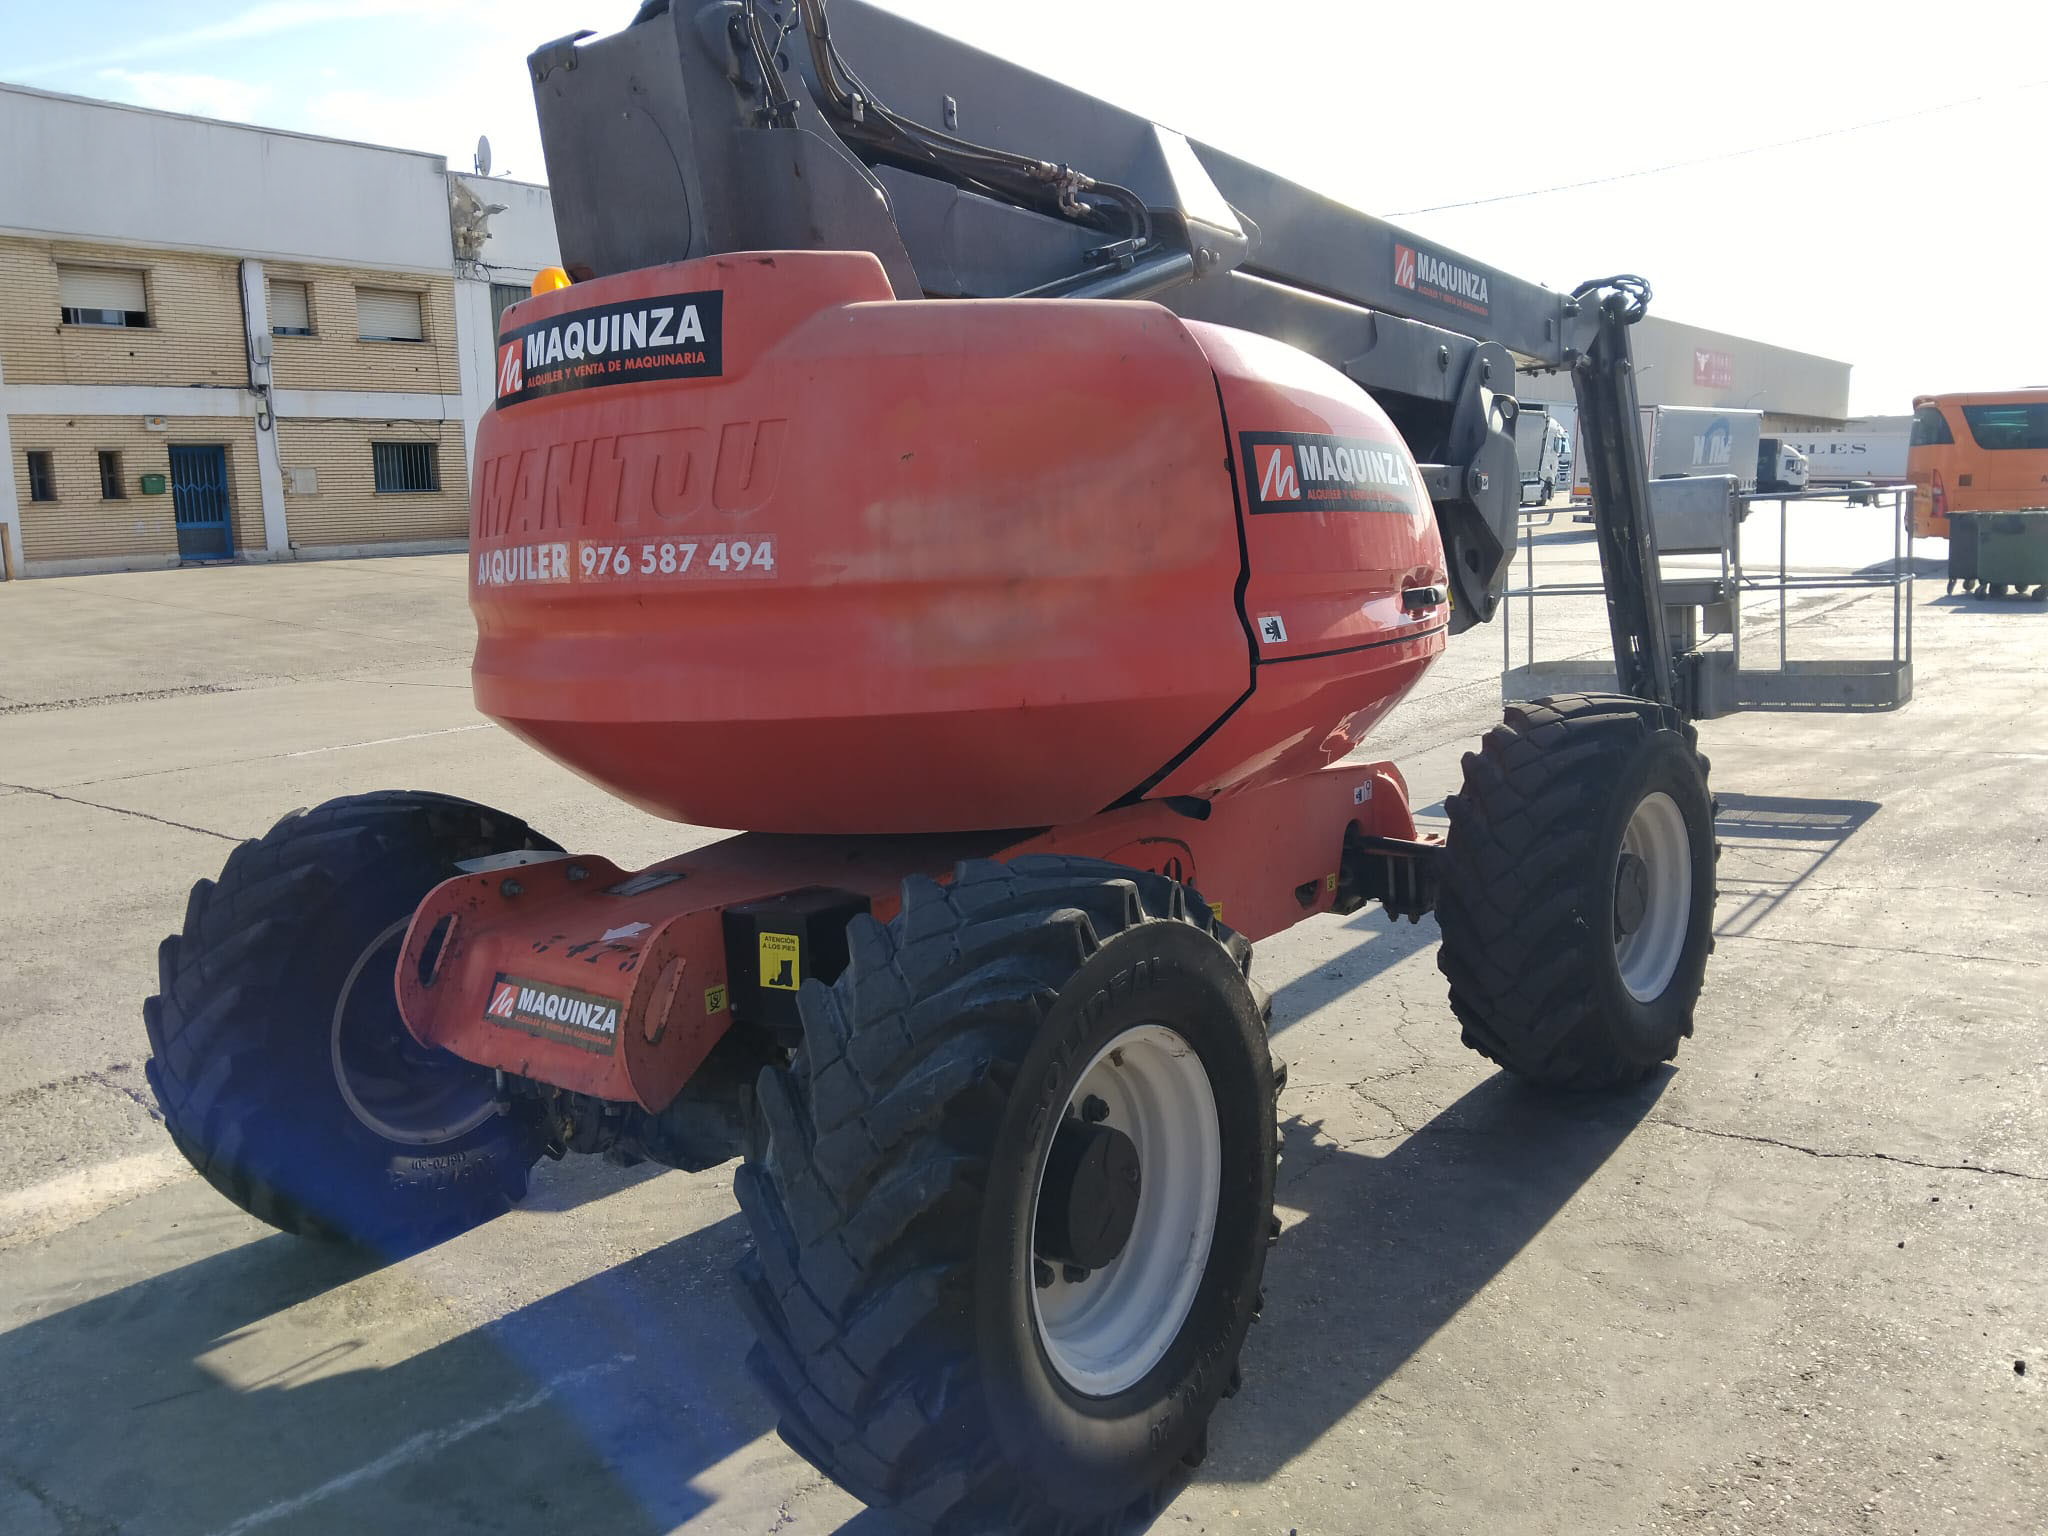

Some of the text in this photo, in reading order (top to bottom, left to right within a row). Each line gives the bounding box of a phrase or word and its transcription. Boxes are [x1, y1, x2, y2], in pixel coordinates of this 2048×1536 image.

[1417, 252, 1488, 303] MAQUINZA
[526, 304, 705, 370] MAQUINZA
[527, 352, 706, 388] ALQUILER Y VENTA DE MAQUINARIA
[1298, 445, 1410, 487] MAQUINZA
[478, 541, 774, 586] ALQUILER 976 587 494
[517, 987, 616, 1034] MAQUINZA
